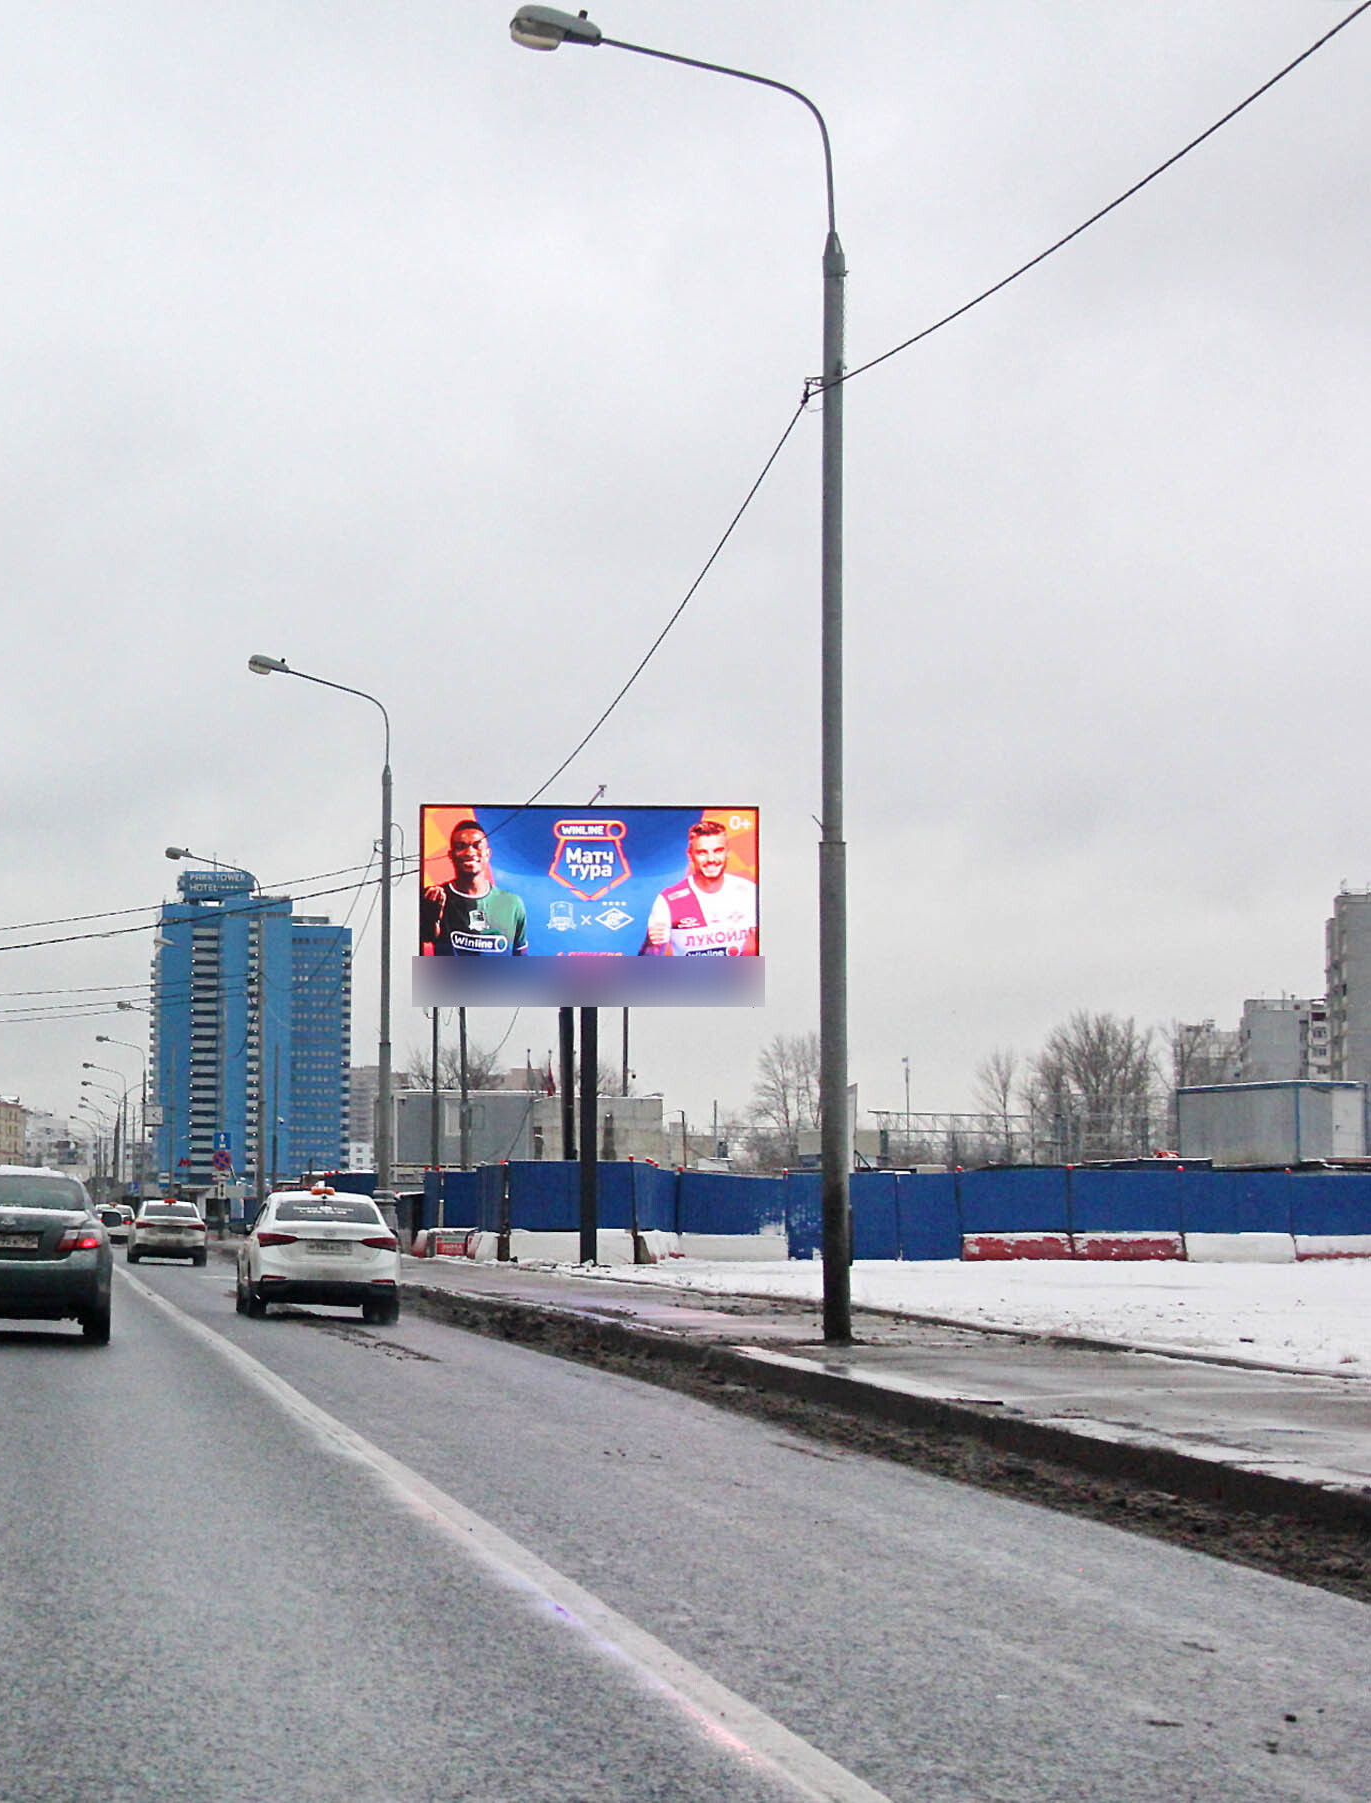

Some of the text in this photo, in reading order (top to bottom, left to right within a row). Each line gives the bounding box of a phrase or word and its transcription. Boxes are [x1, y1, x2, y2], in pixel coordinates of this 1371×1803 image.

[729, 815, 751, 830] 0+
[565, 847, 614, 864] Матч
[189, 873, 246, 882] PARK TOWER
[568, 864, 613, 881] тура
[189, 883, 218, 891] HOTEL
